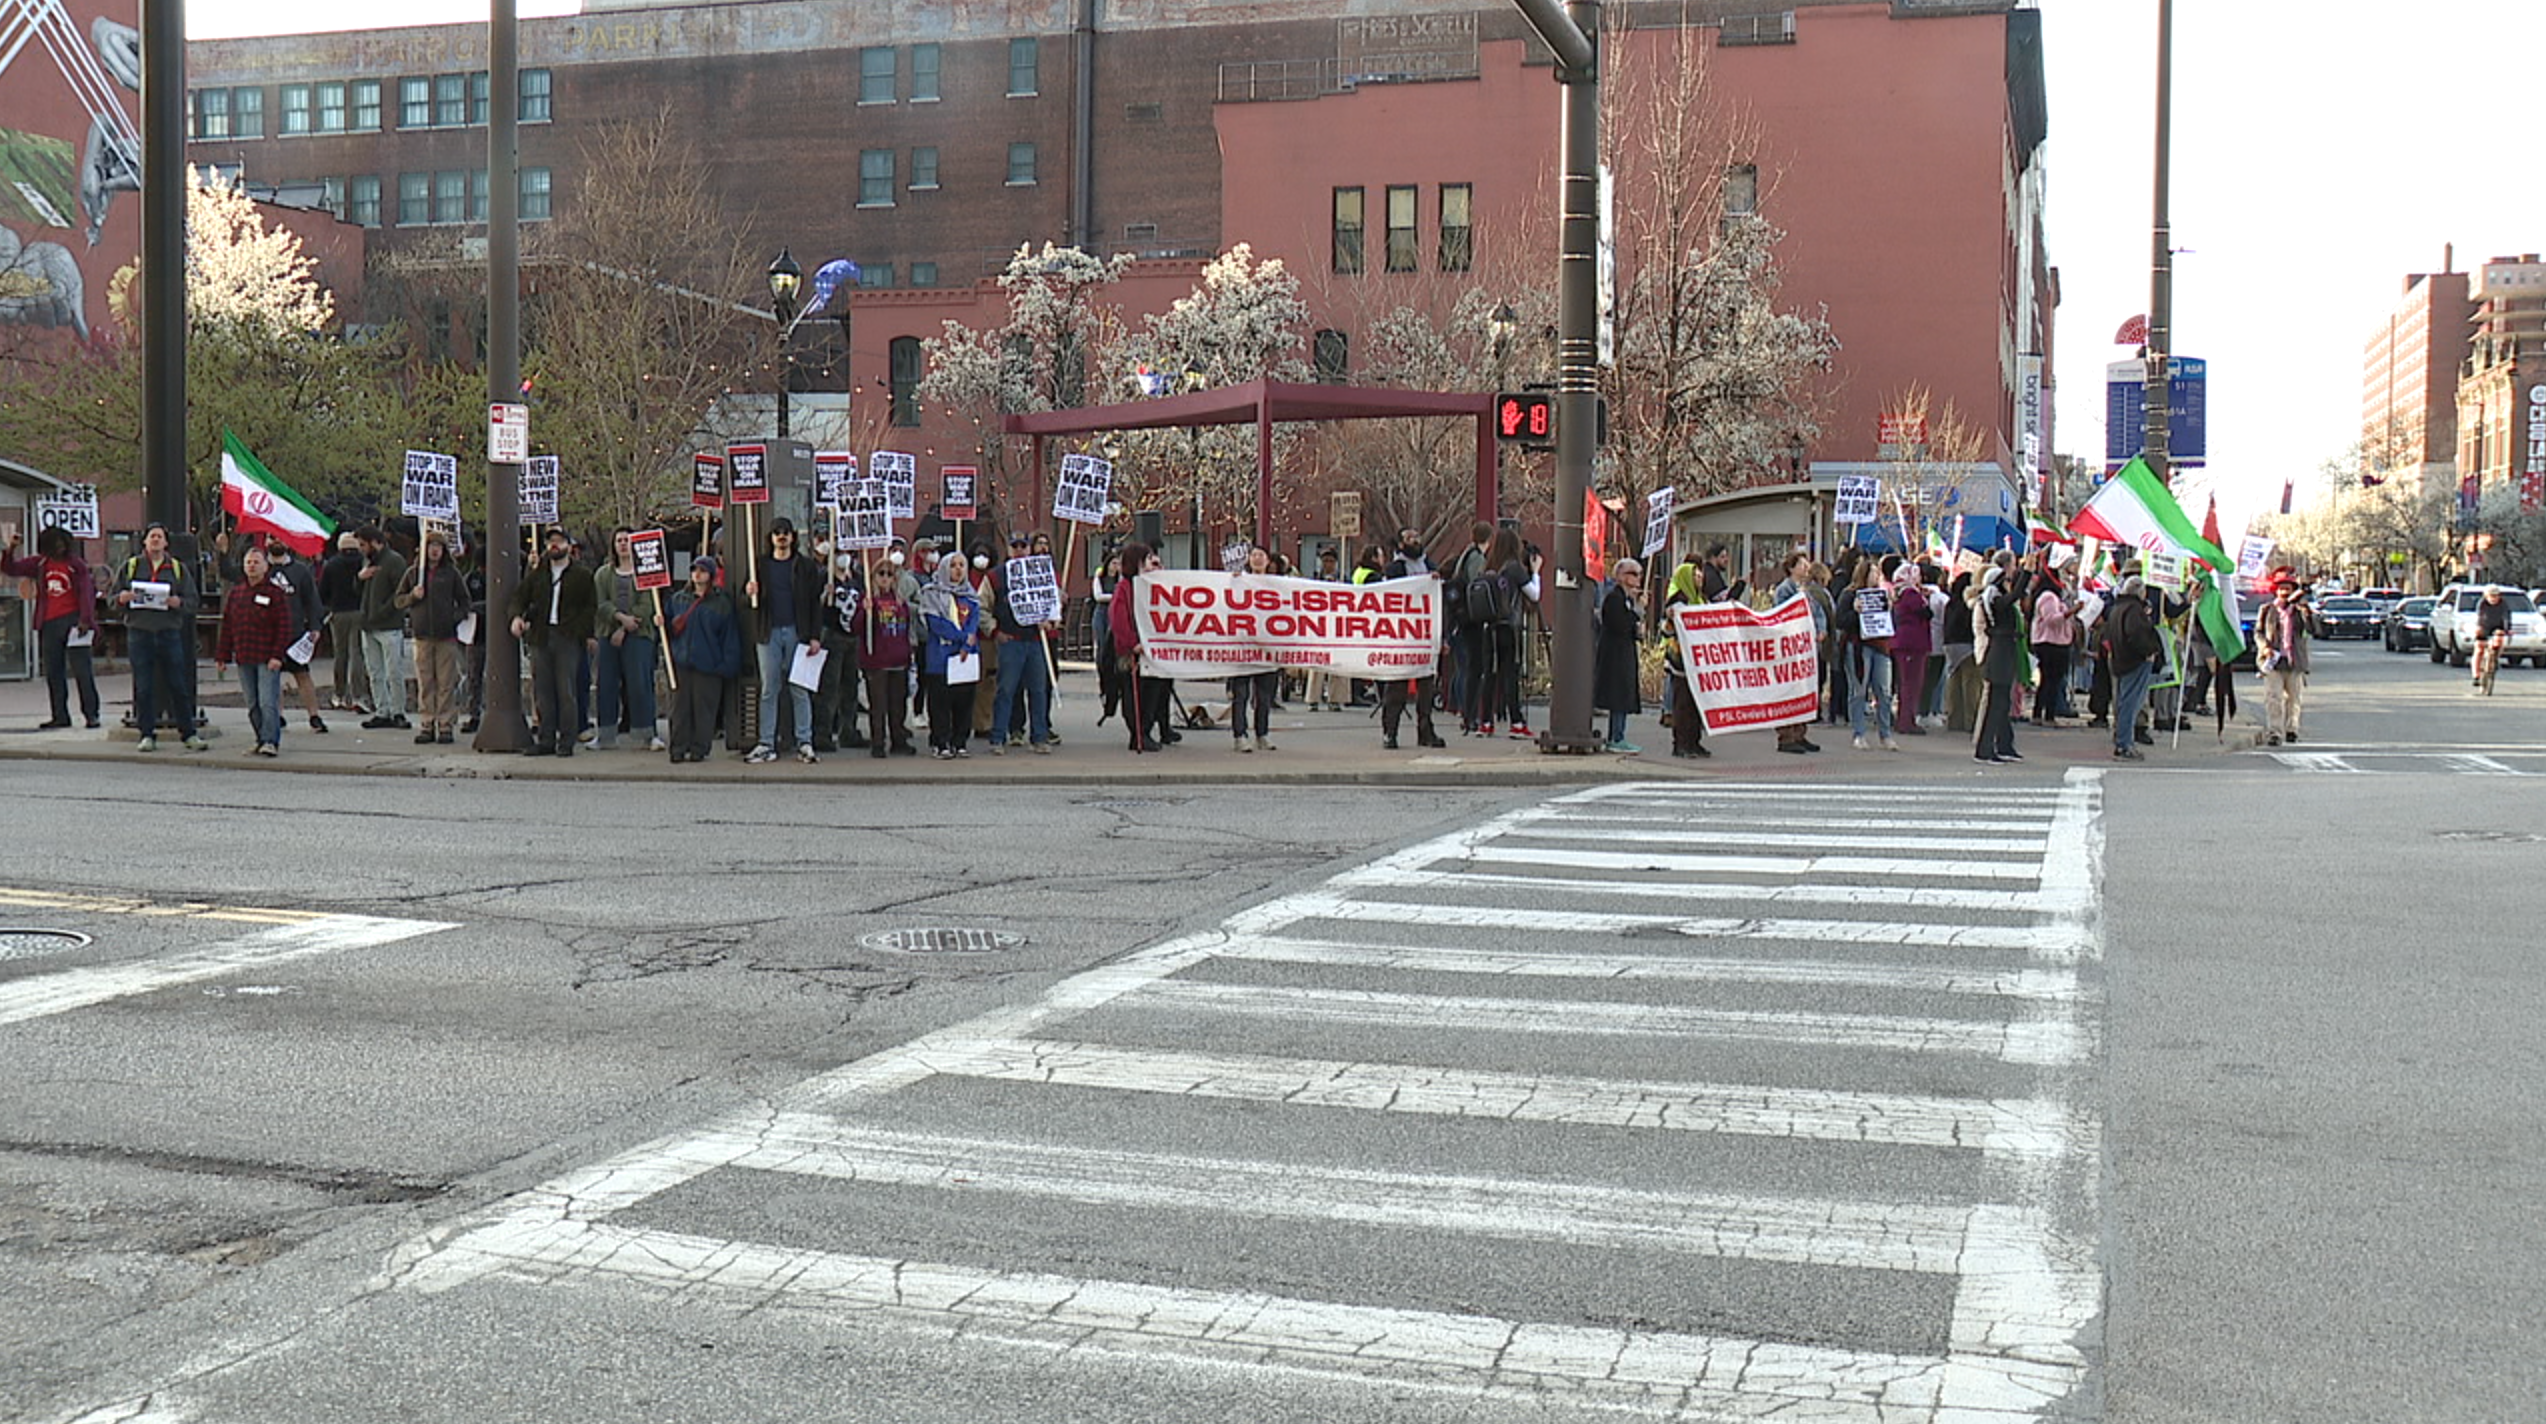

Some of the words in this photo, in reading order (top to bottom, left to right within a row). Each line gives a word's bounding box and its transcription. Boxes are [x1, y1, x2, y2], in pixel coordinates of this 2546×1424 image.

[2023, 375, 2039, 417] bright
[498, 439, 519, 449] STOP
[407, 453, 433, 469] STOP
[435, 456, 453, 472] THE
[697, 463, 721, 471] STOP
[733, 455, 761, 464] STOP
[735, 463, 759, 472] WAR
[1065, 457, 1091, 470] STOP
[530, 459, 556, 477] NEW
[740, 471, 756, 479] ON
[407, 469, 453, 487] WAR
[528, 476, 555, 489] WAR
[873, 469, 912, 484] WAR
[946, 475, 972, 483] STOP
[1063, 470, 1108, 489] WAR
[405, 483, 421, 505] ON
[836, 481, 863, 496] STOP
[865, 481, 887, 495] THE
[948, 482, 970, 490] WAR
[1840, 488, 1876, 498] WAR
[528, 490, 555, 502] THE
[889, 486, 912, 508] RAN
[1058, 484, 1075, 507] ON
[838, 496, 887, 512] WAR
[42, 508, 94, 531] OPEN
[839, 513, 856, 538] ON
[634, 540, 660, 551] STOP
[637, 549, 659, 559] WAR
[641, 557, 657, 565] ON
[1010, 561, 1024, 578] NO
[1026, 557, 1053, 576] NEW
[1010, 579, 1026, 591] US
[1027, 575, 1055, 589] WAR
[1011, 591, 1026, 603] IN
[1028, 588, 1056, 602] THE
[1150, 584, 1216, 609] NO
[1150, 611, 1256, 636] WAR
[1266, 615, 1327, 637] ON
[1335, 617, 1432, 640] IRAN!
[1151, 648, 1181, 661] PARTY
[1184, 650, 1204, 662] FOR
[1207, 649, 1262, 663] SOCIALISM
[1276, 650, 1331, 665] LIBERATION
[1692, 642, 1739, 666] FIGHT
[1740, 639, 1775, 662] THE
[1780, 631, 1812, 657] RICH
[1698, 669, 1731, 692] NOT
[1732, 667, 1771, 689] THEIR
[1773, 657, 1816, 684] WARS!
